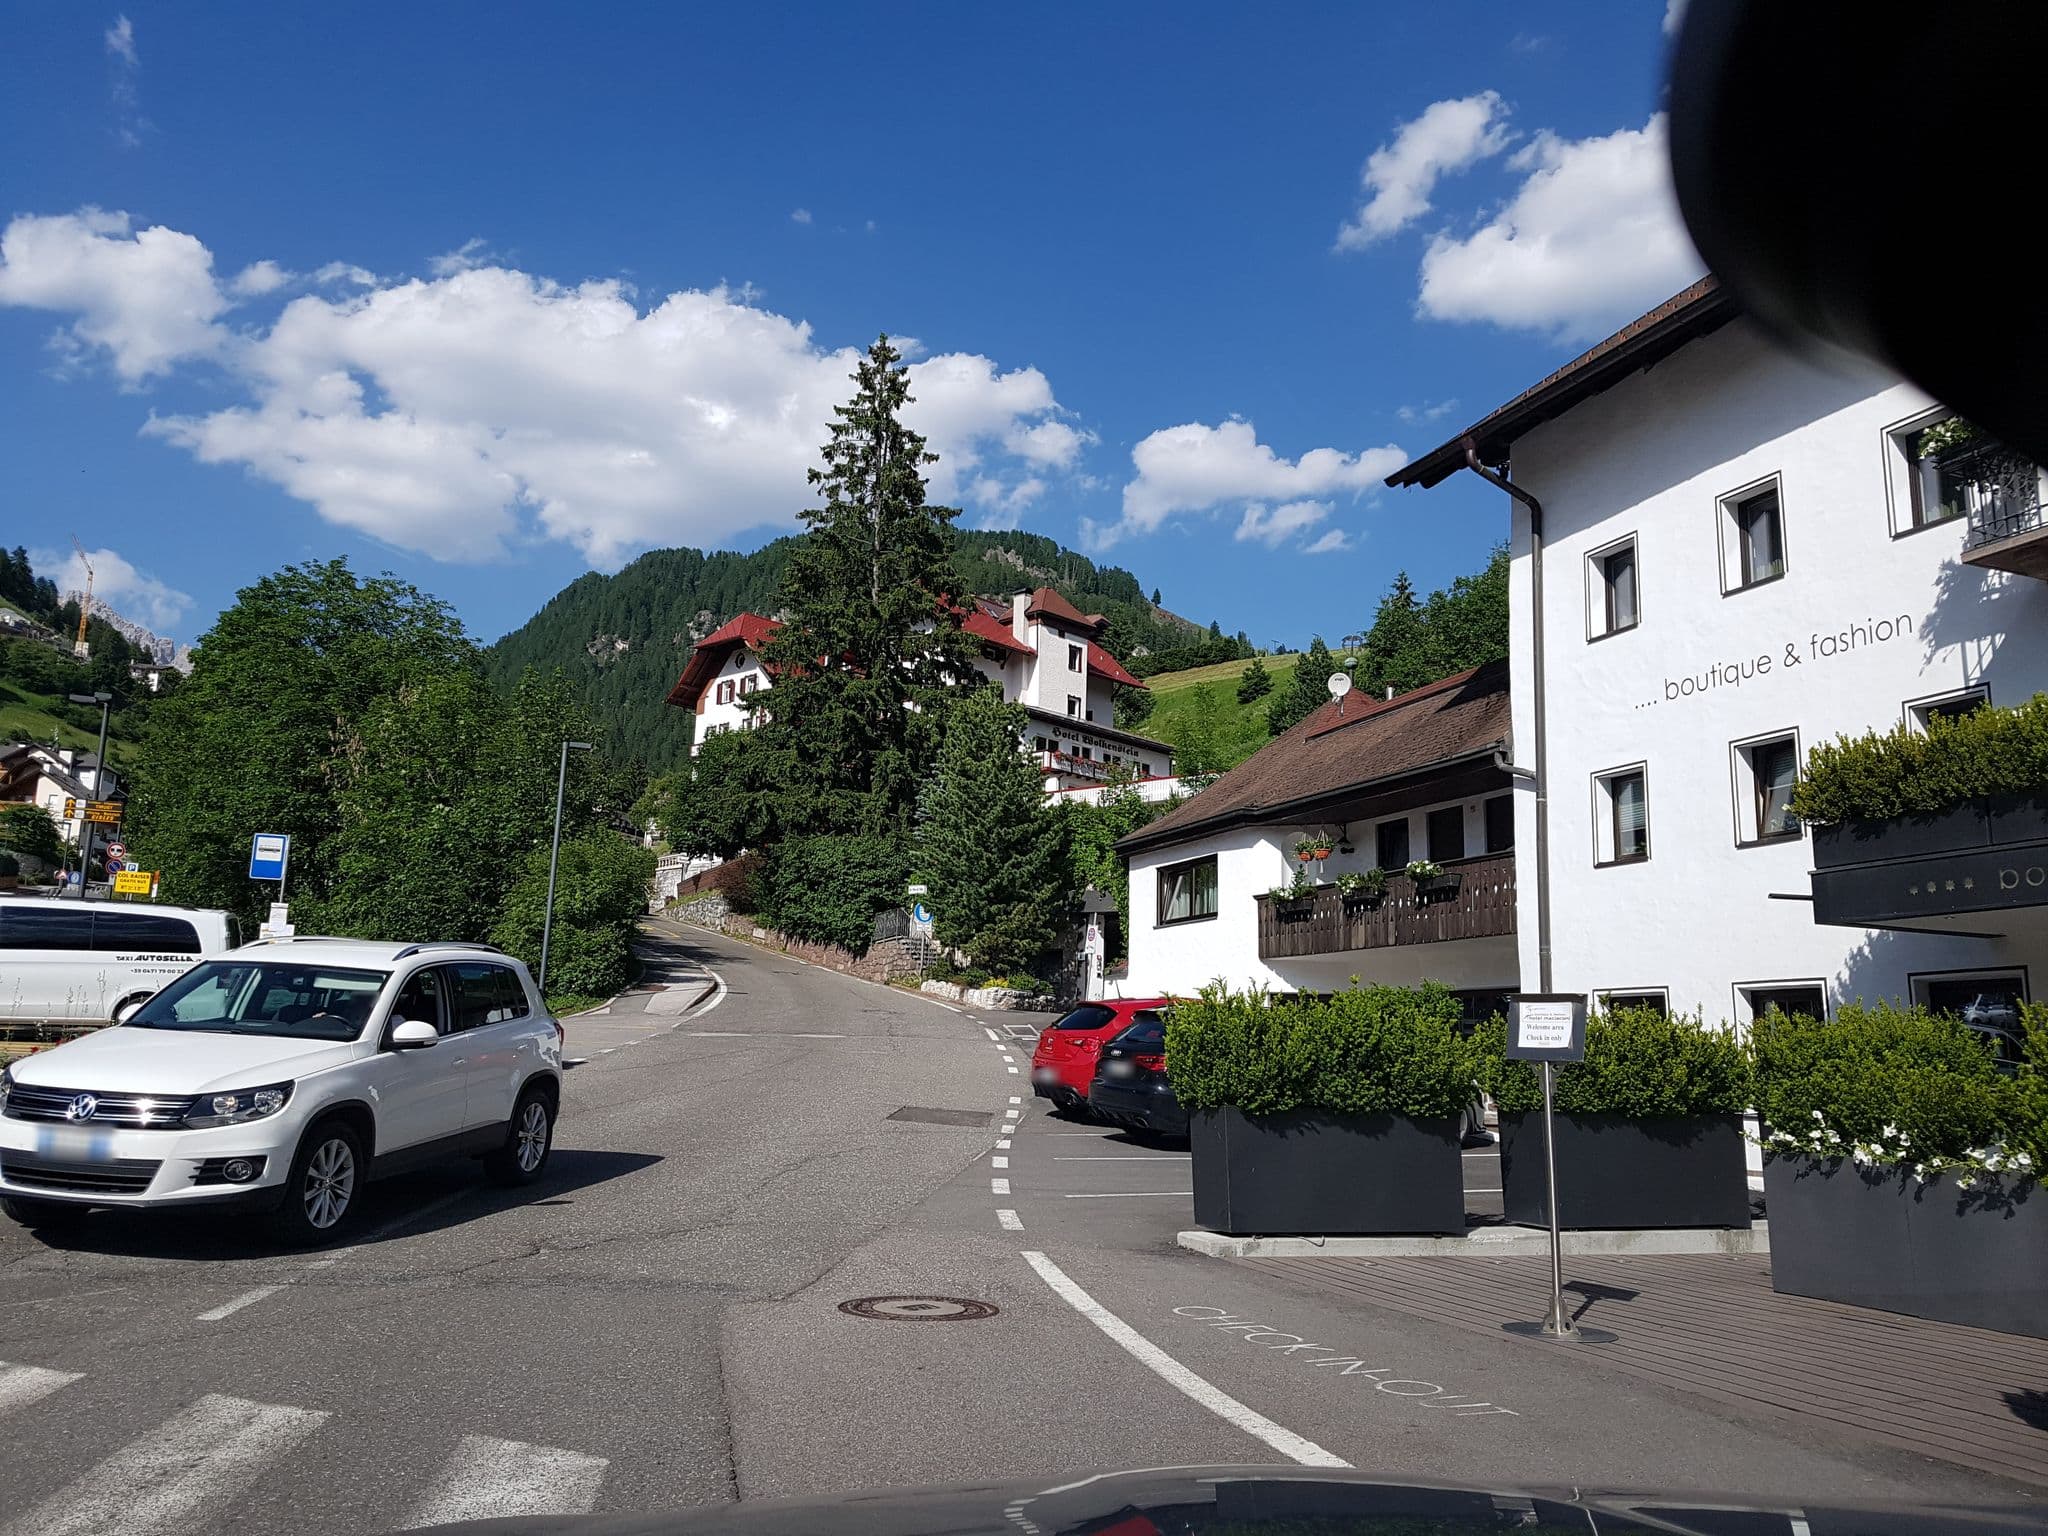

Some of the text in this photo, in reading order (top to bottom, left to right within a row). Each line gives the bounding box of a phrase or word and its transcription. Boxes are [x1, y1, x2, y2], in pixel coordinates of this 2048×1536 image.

[1663, 654, 1773, 701] boutique
[1783, 642, 1802, 668] &
[1809, 614, 1914, 660] fashion
[1052, 726, 1079, 742] Hotel
[1526, 1023, 1551, 1031] Welcome
[1551, 1034, 1562, 1042] only
[1172, 1305, 1521, 1417] CHECK IN-OUT
